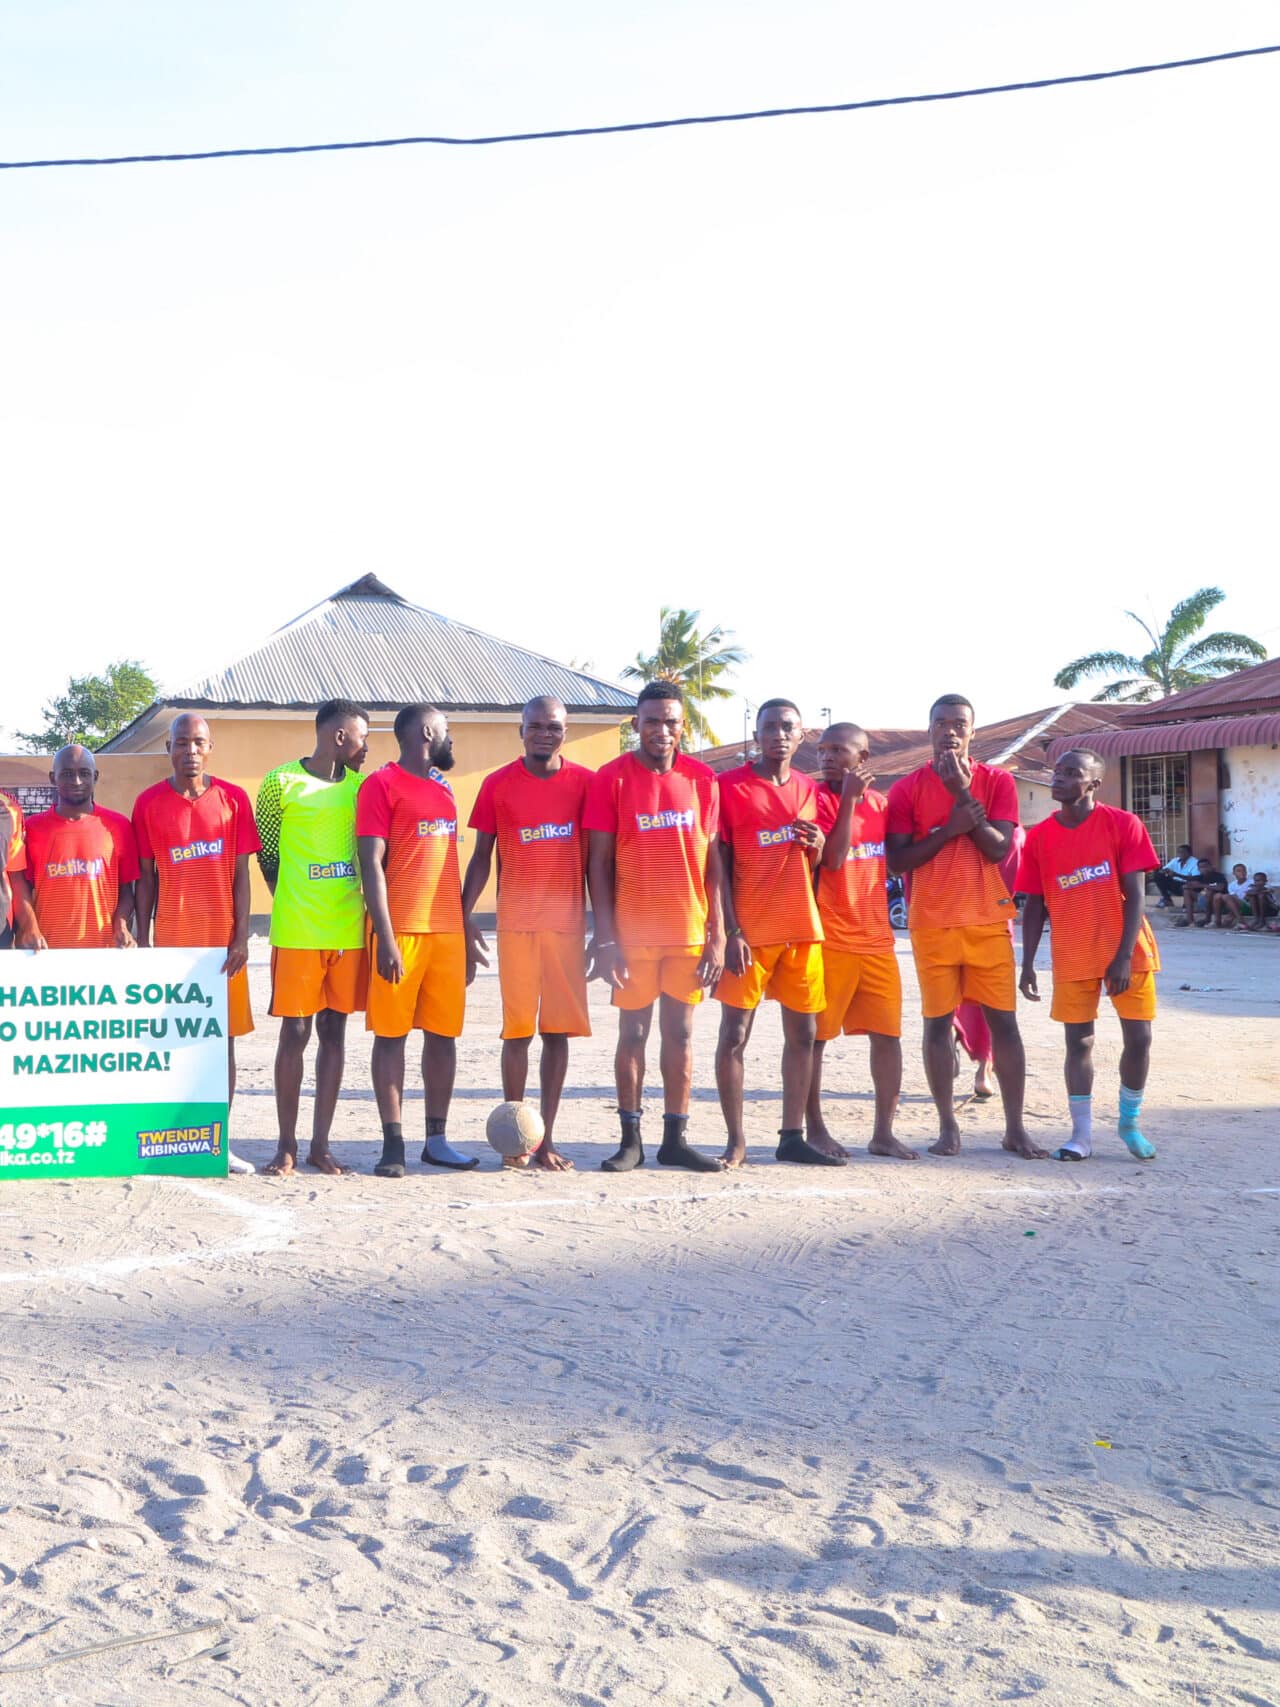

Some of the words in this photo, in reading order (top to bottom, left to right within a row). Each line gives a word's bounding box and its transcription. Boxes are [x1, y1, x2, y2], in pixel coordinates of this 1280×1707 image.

[418, 818, 456, 835] Betika
[521, 823, 573, 842] Betika!
[760, 827, 793, 845] Beti
[171, 839, 222, 862] Betika!
[310, 862, 354, 878] Betika
[1058, 861, 1111, 889] Betika!
[125, 983, 213, 1008] SOKA,
[24, 1018, 168, 1042] UHARIBIFU
[175, 1017, 223, 1039] WA
[13, 1051, 171, 1075] MAZINGIRA!
[138, 1127, 211, 1145] TWENDE
